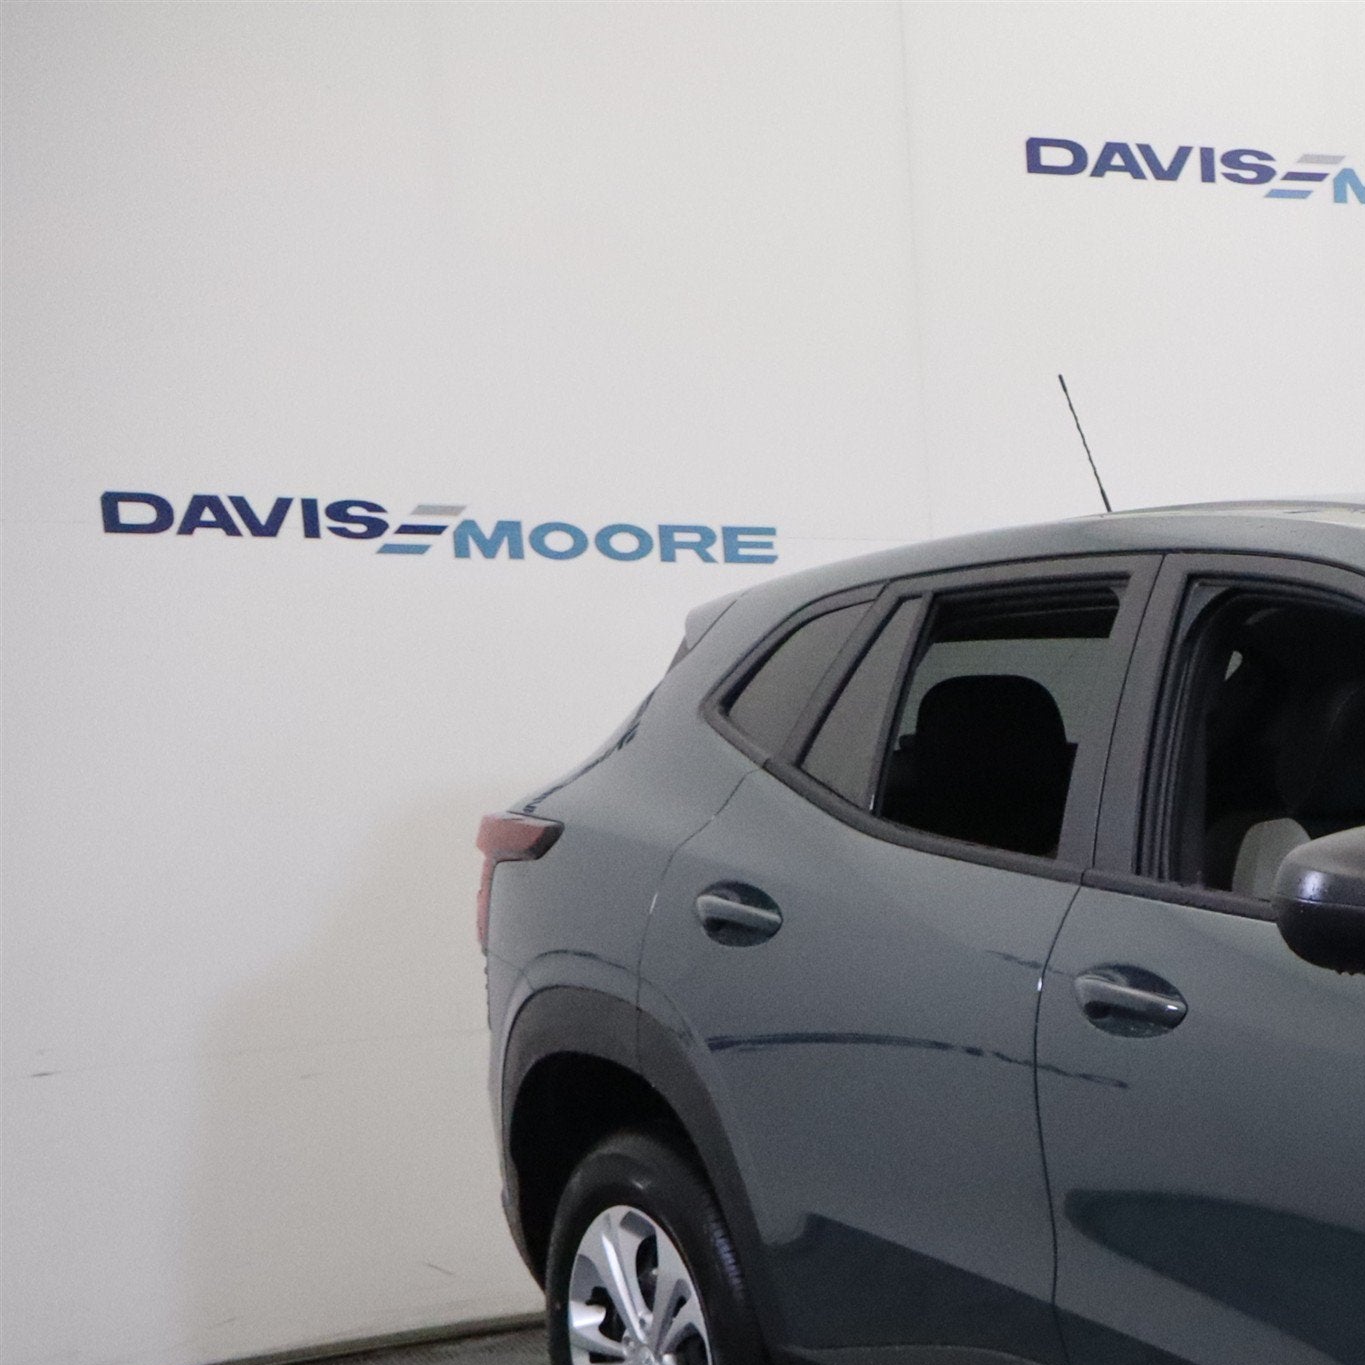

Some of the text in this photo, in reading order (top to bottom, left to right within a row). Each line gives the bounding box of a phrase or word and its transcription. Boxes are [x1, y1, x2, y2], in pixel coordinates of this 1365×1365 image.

[1024, 137, 1278, 186] DAVIS
[98, 490, 779, 565] DAVIS MOORE
